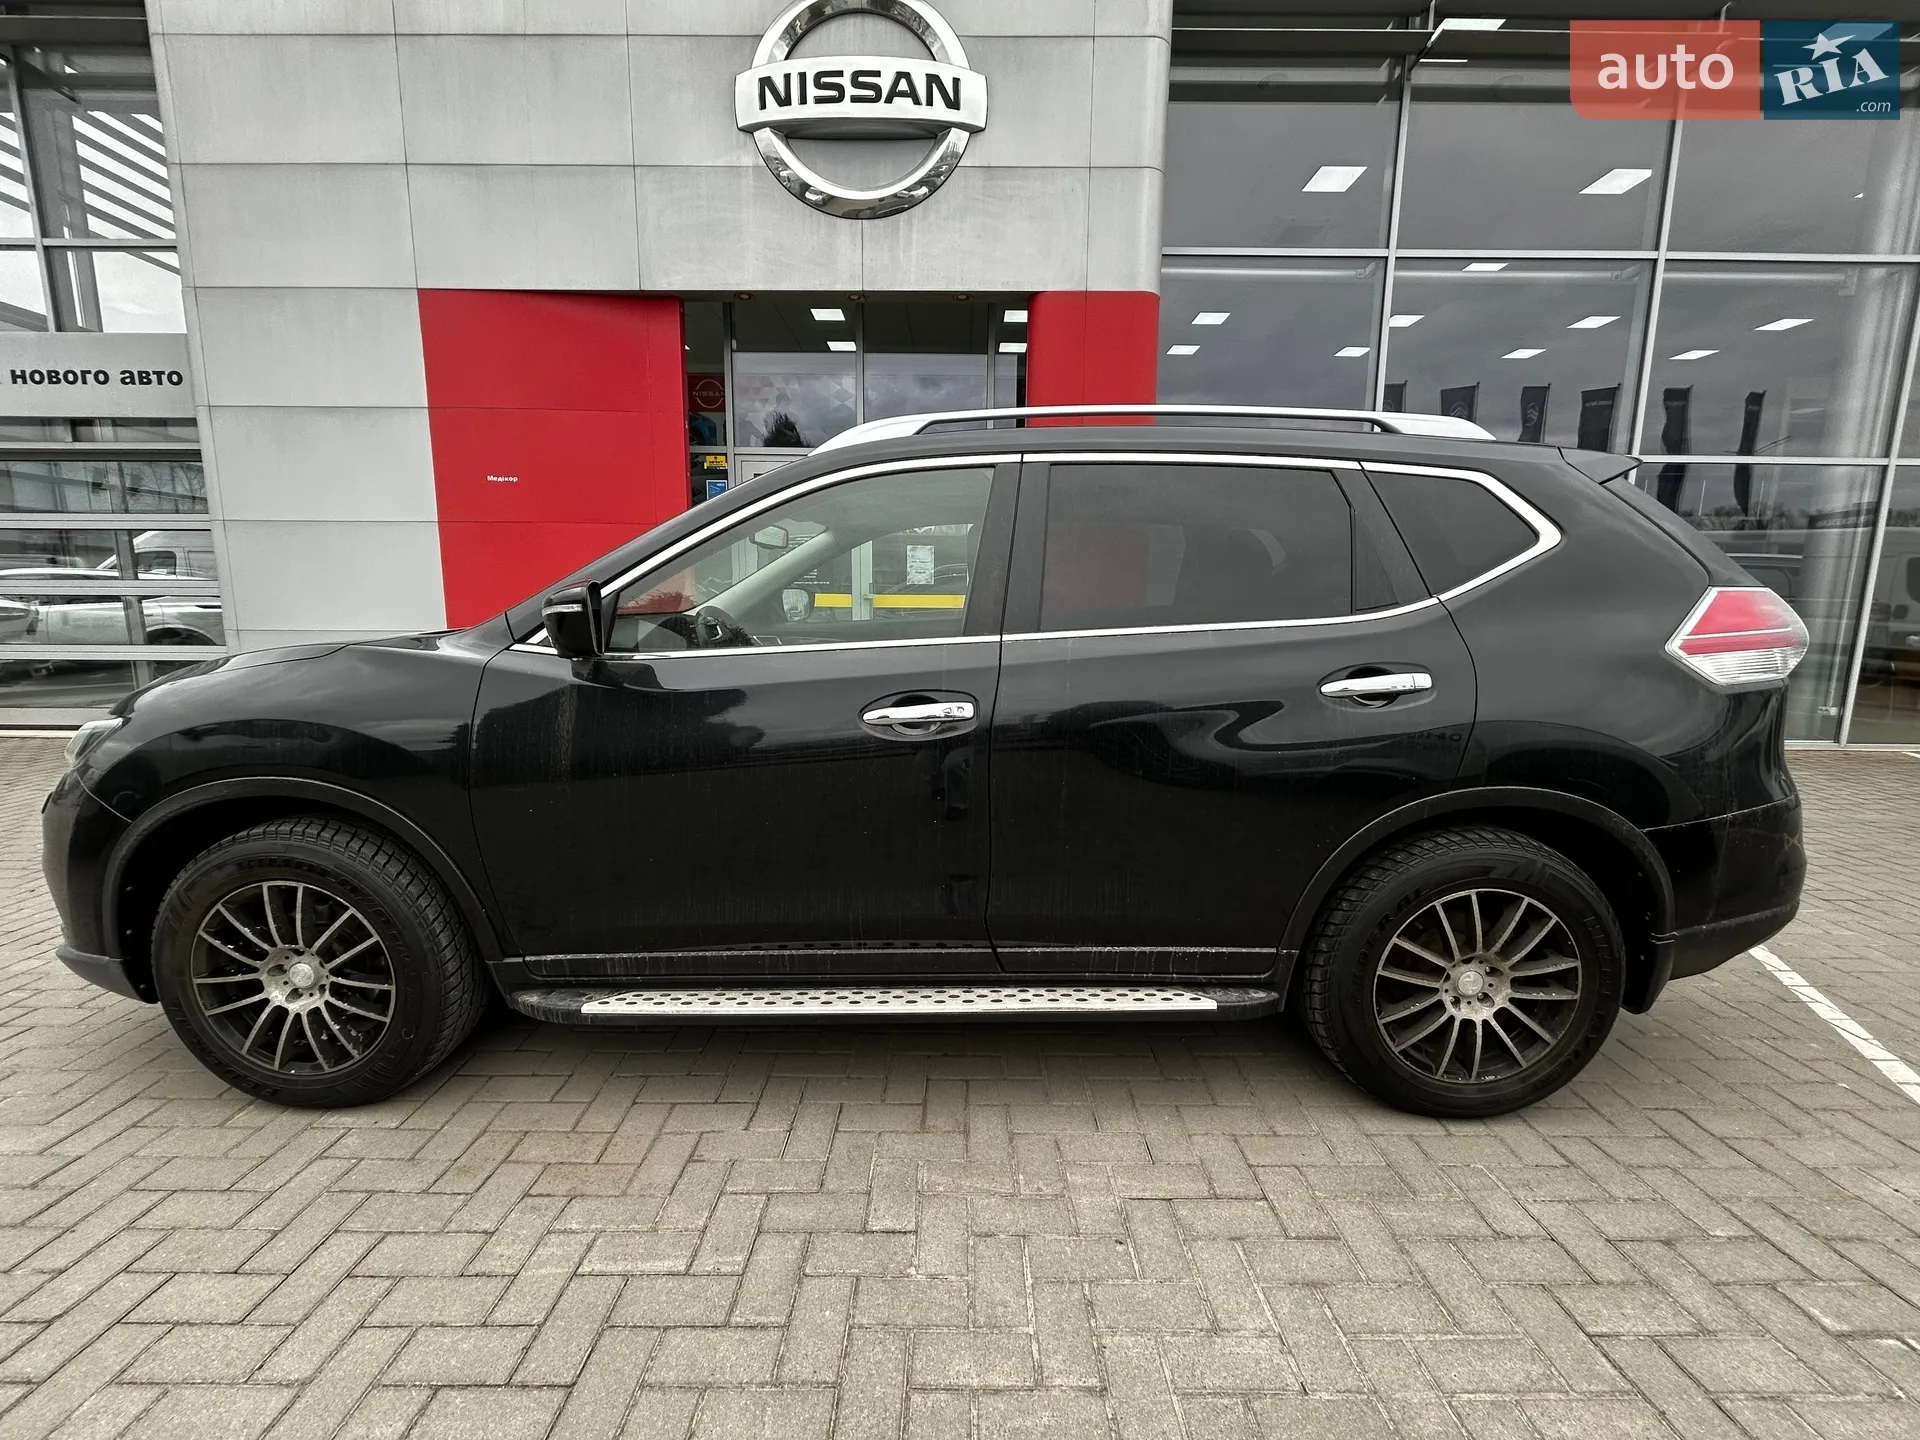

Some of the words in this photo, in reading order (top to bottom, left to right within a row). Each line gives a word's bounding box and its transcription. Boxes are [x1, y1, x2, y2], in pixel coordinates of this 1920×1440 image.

[758, 69, 961, 111] NISSAN
[10, 369, 110, 385] нового
[119, 369, 184, 386] авто
[487, 475, 518, 483] Медікор
